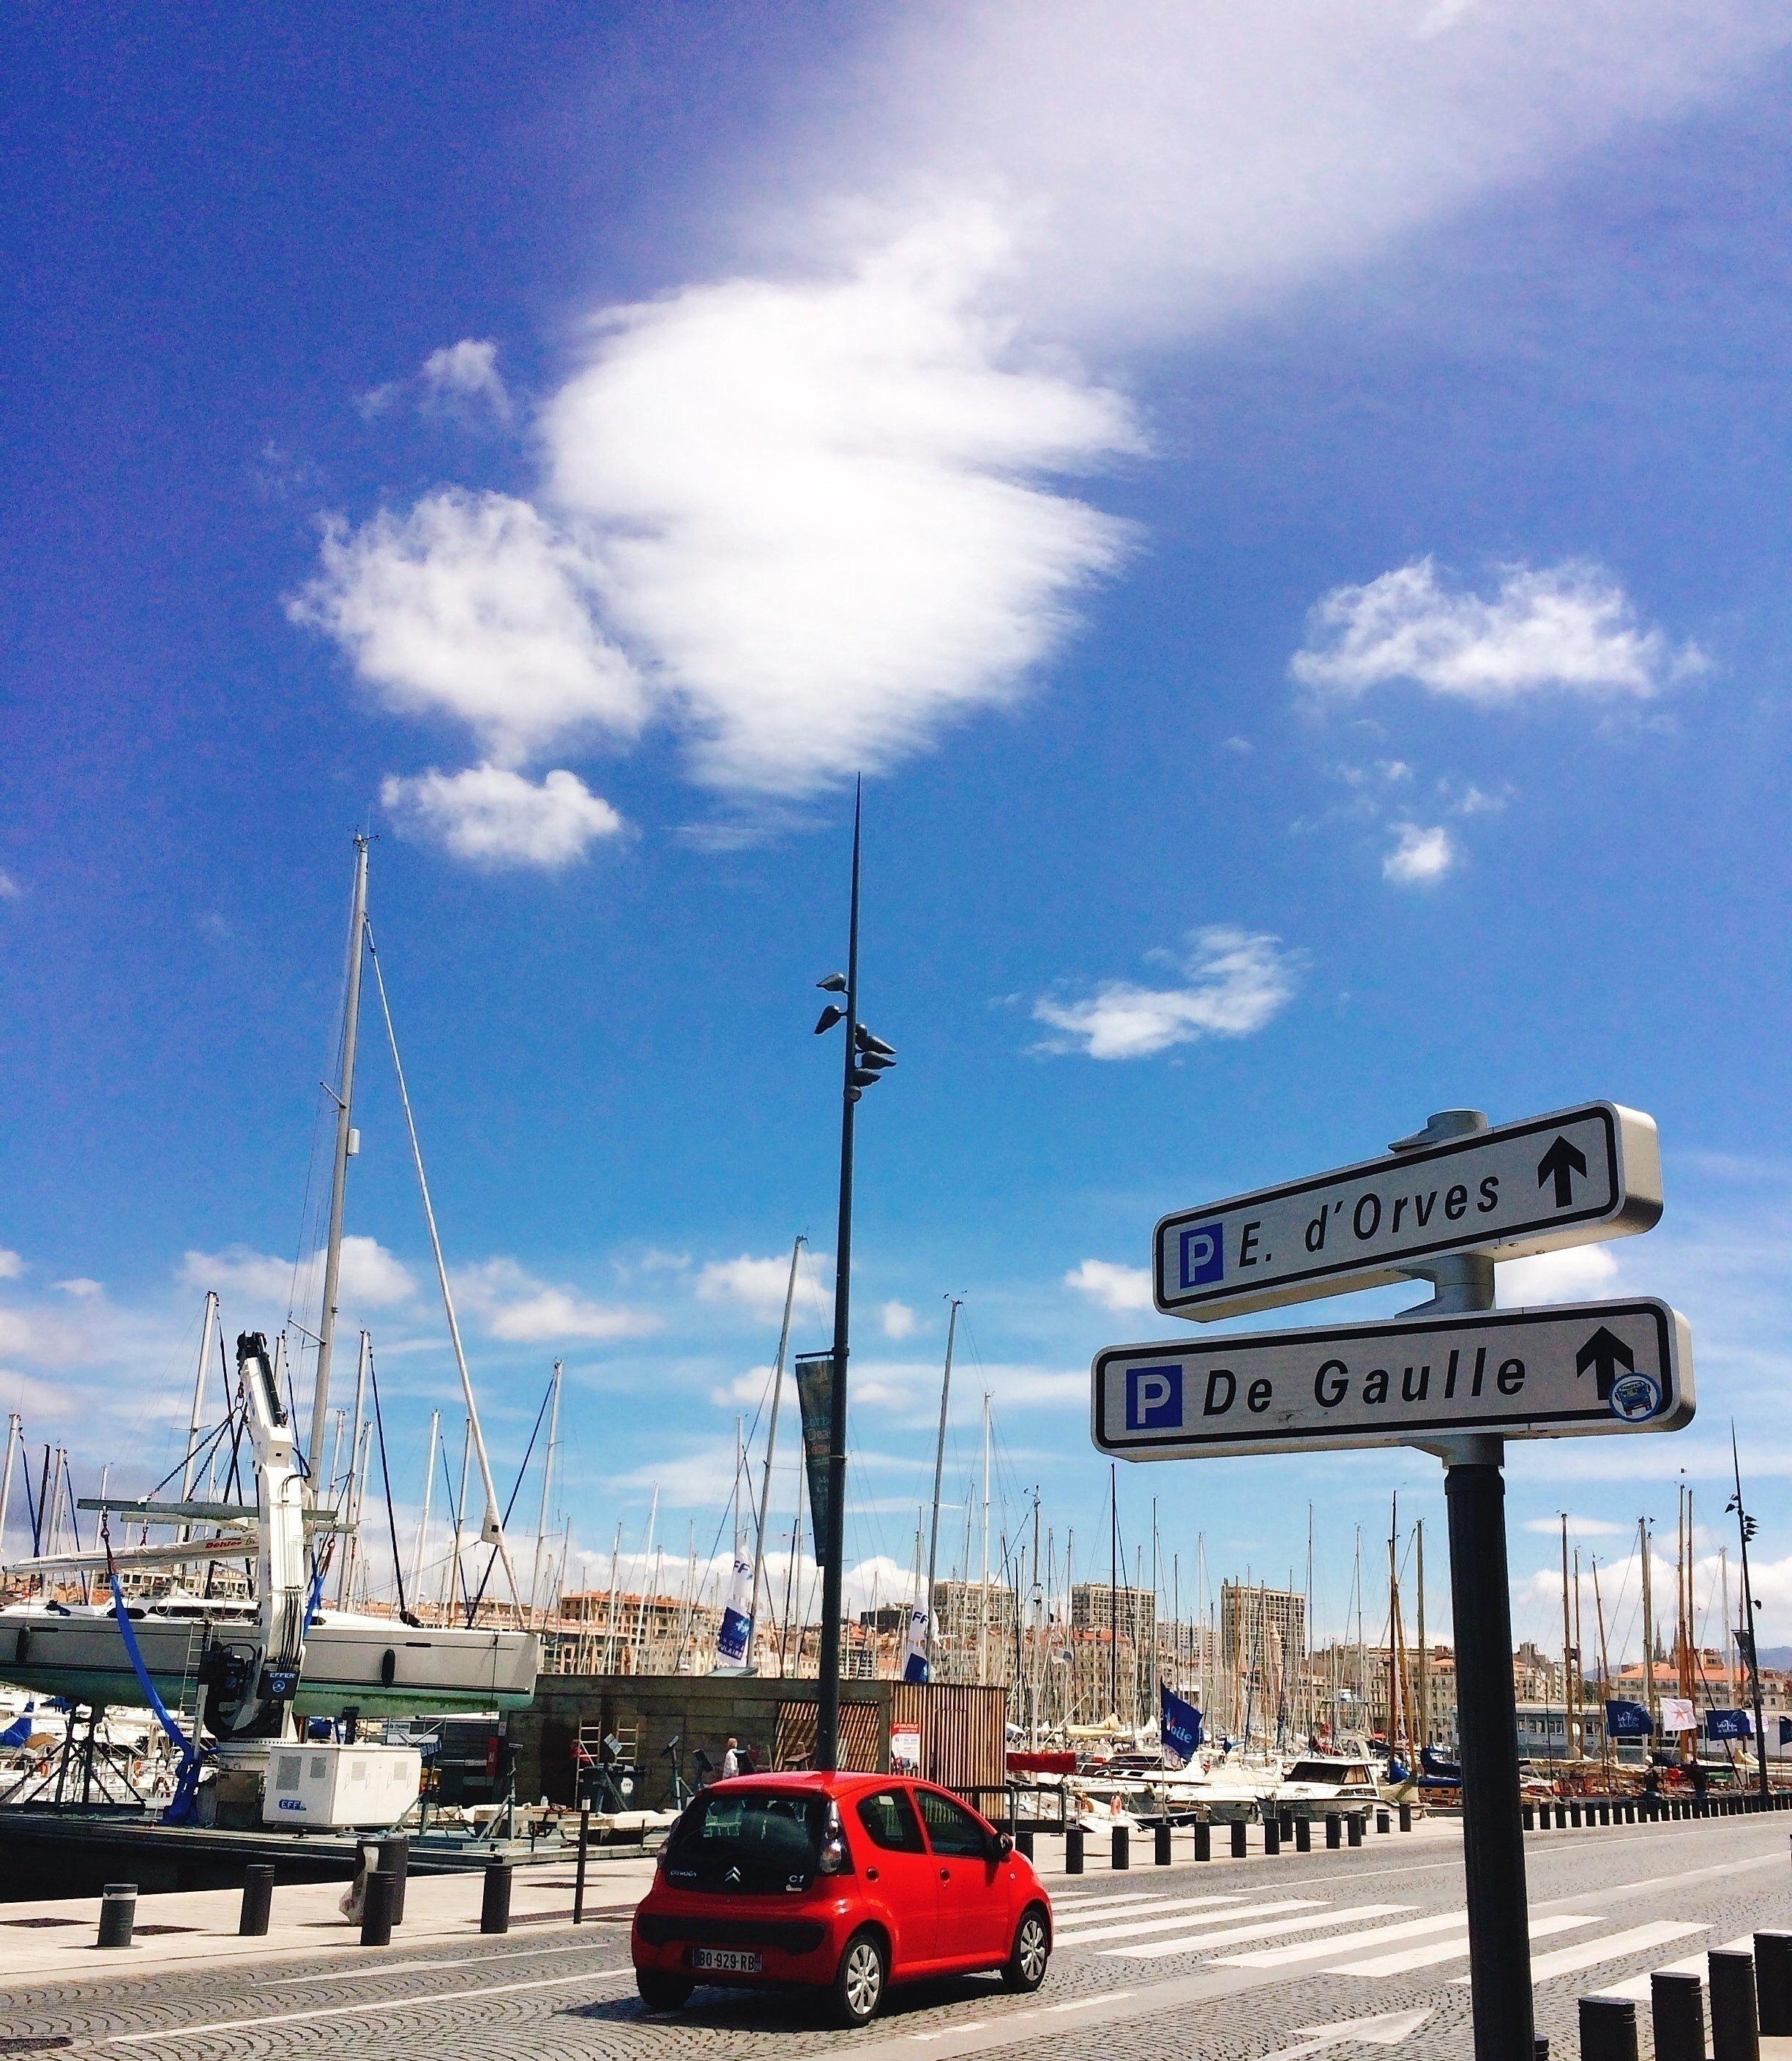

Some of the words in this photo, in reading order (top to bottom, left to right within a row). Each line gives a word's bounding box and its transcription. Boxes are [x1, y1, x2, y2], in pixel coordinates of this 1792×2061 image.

[1187, 1237, 1215, 1282] P
[1238, 1220, 1272, 1268] E.
[1304, 1176, 1499, 1253] d'Orves
[1137, 1374, 1171, 1424] P
[1203, 1369, 1273, 1417] De
[1314, 1346, 1526, 1409] Gaulle
[788, 1874, 804, 1883] C1
